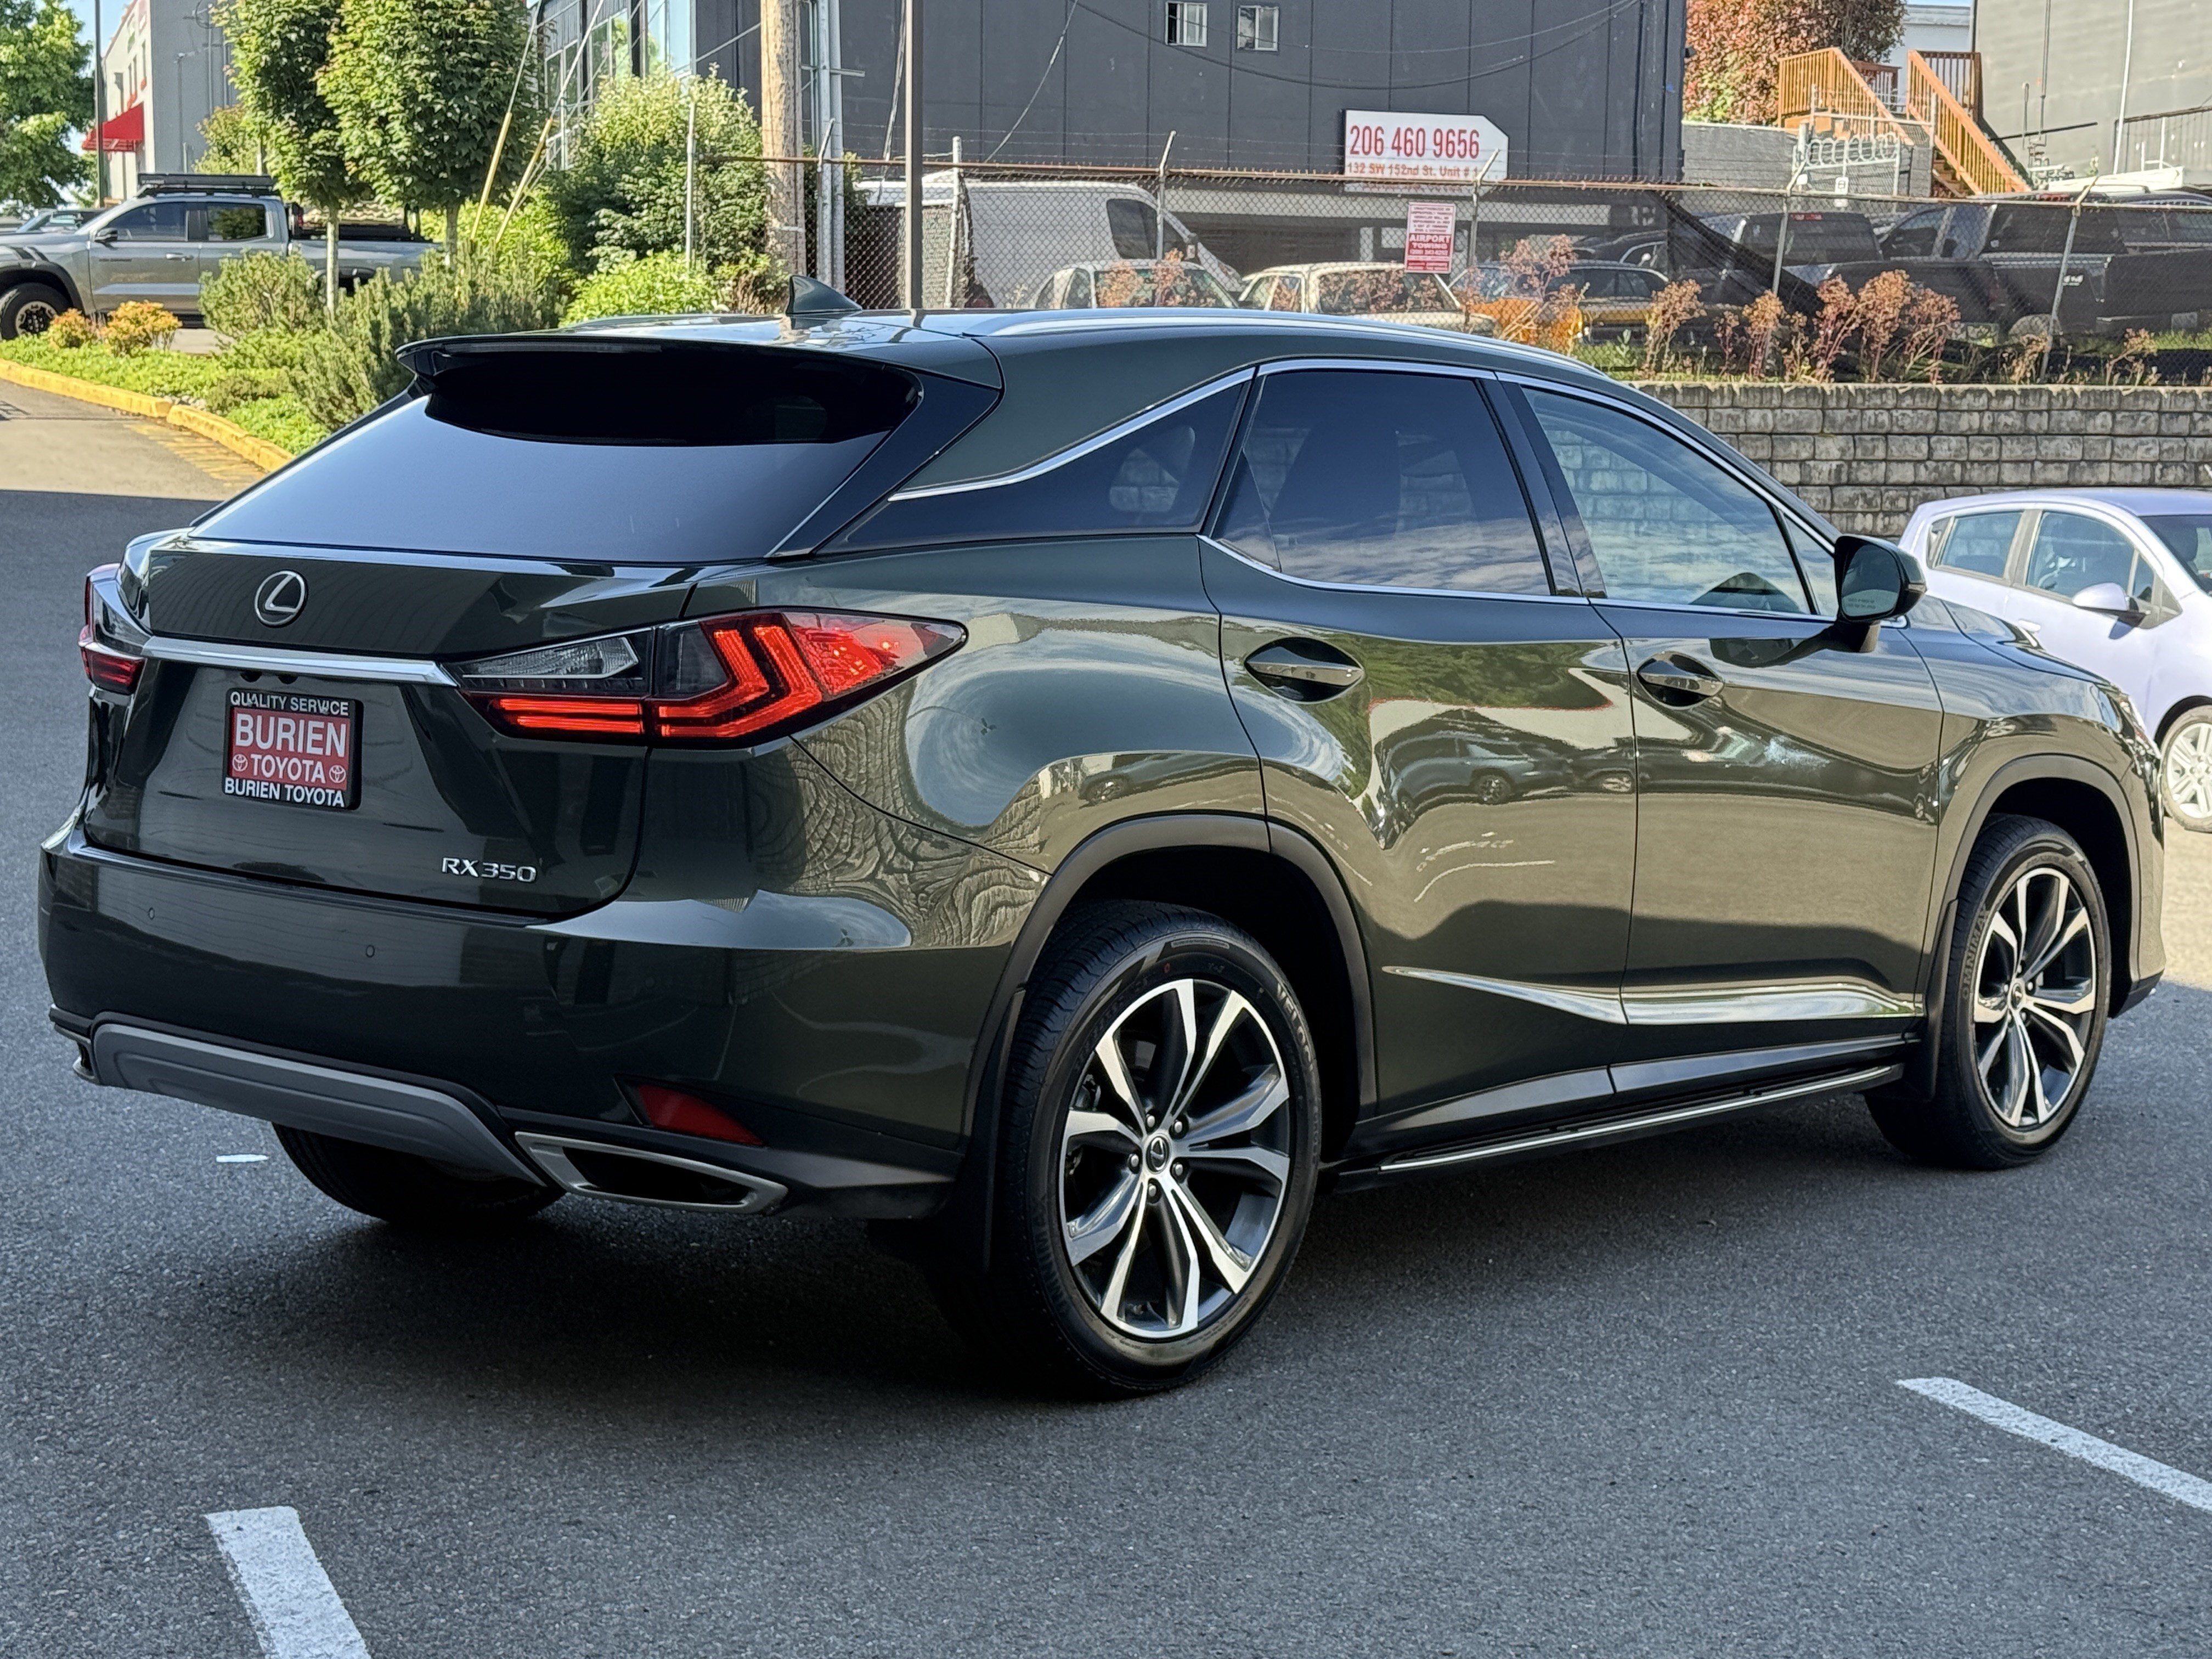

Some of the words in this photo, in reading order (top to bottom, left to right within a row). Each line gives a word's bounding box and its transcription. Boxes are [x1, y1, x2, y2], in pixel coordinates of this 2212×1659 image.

[1350, 125, 1385, 156] 206
[1391, 127, 1426, 157] 460
[1433, 128, 1480, 159] 9656
[1347, 162, 1365, 173] 132
[1369, 163, 1385, 174] SW
[1388, 163, 1419, 176] 152nd
[1439, 166, 1460, 177] Unit
[1409, 234, 1451, 243] AIRPORT
[230, 691, 287, 709] QUALITY
[290, 697, 349, 715] SERVICE
[235, 713, 346, 758] BURIEN
[250, 753, 326, 784] TOYOTA
[224, 777, 280, 800] BURIEN
[284, 785, 345, 808] TOYOTA
[1961, 903, 1990, 1000] OMNIMAX
